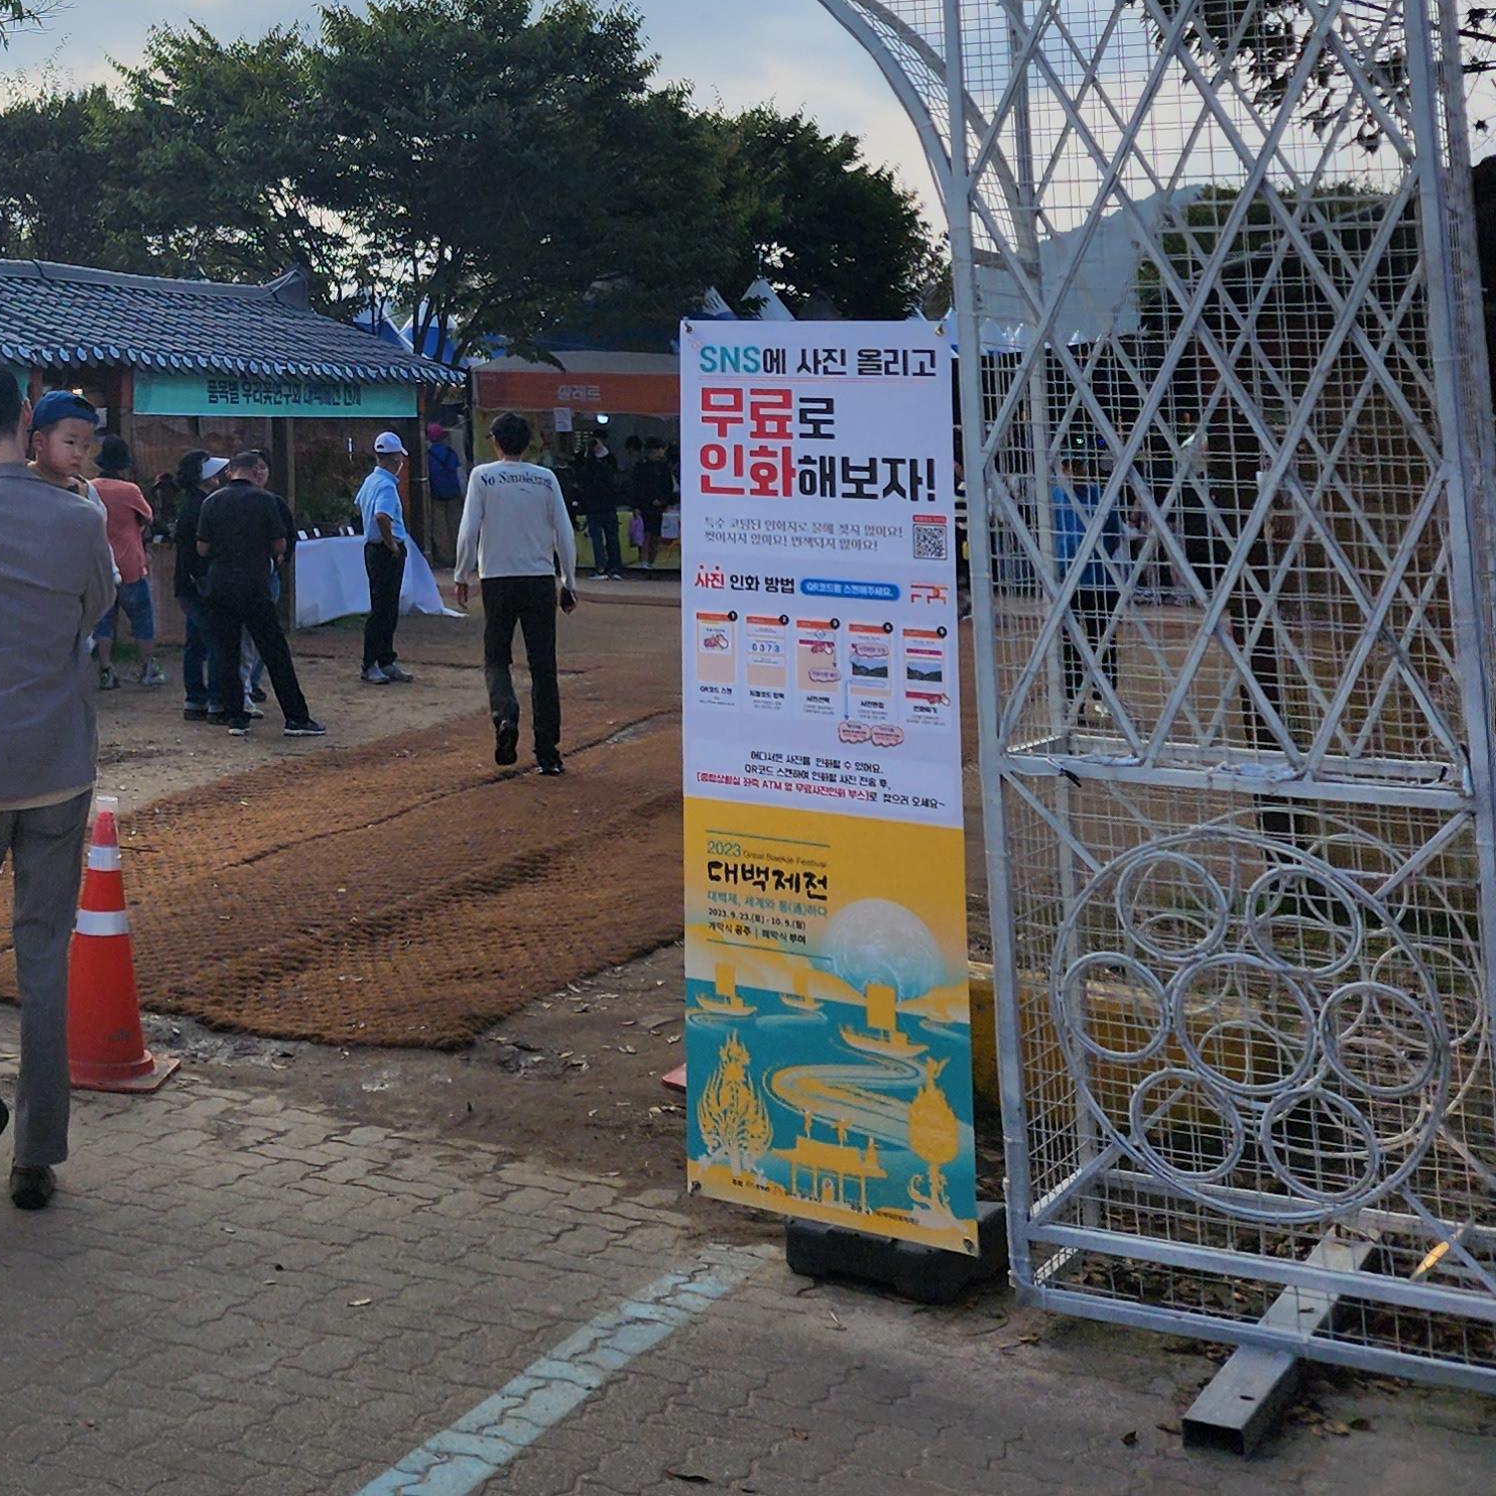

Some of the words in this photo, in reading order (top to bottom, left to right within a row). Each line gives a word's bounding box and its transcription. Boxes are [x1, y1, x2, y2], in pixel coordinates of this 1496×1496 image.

[699, 345, 787, 376] SNS에
[796, 348, 847, 376] 사진
[857, 348, 937, 377] 올리고
[701, 387, 835, 440] 무료로
[699, 444, 936, 502] 인화해보자!
[695, 572, 725, 589] 사진
[730, 574, 760, 592] 인화
[765, 576, 795, 594] 방법
[707, 840, 742, 858] 2023
[707, 860, 828, 901] 대백제전
